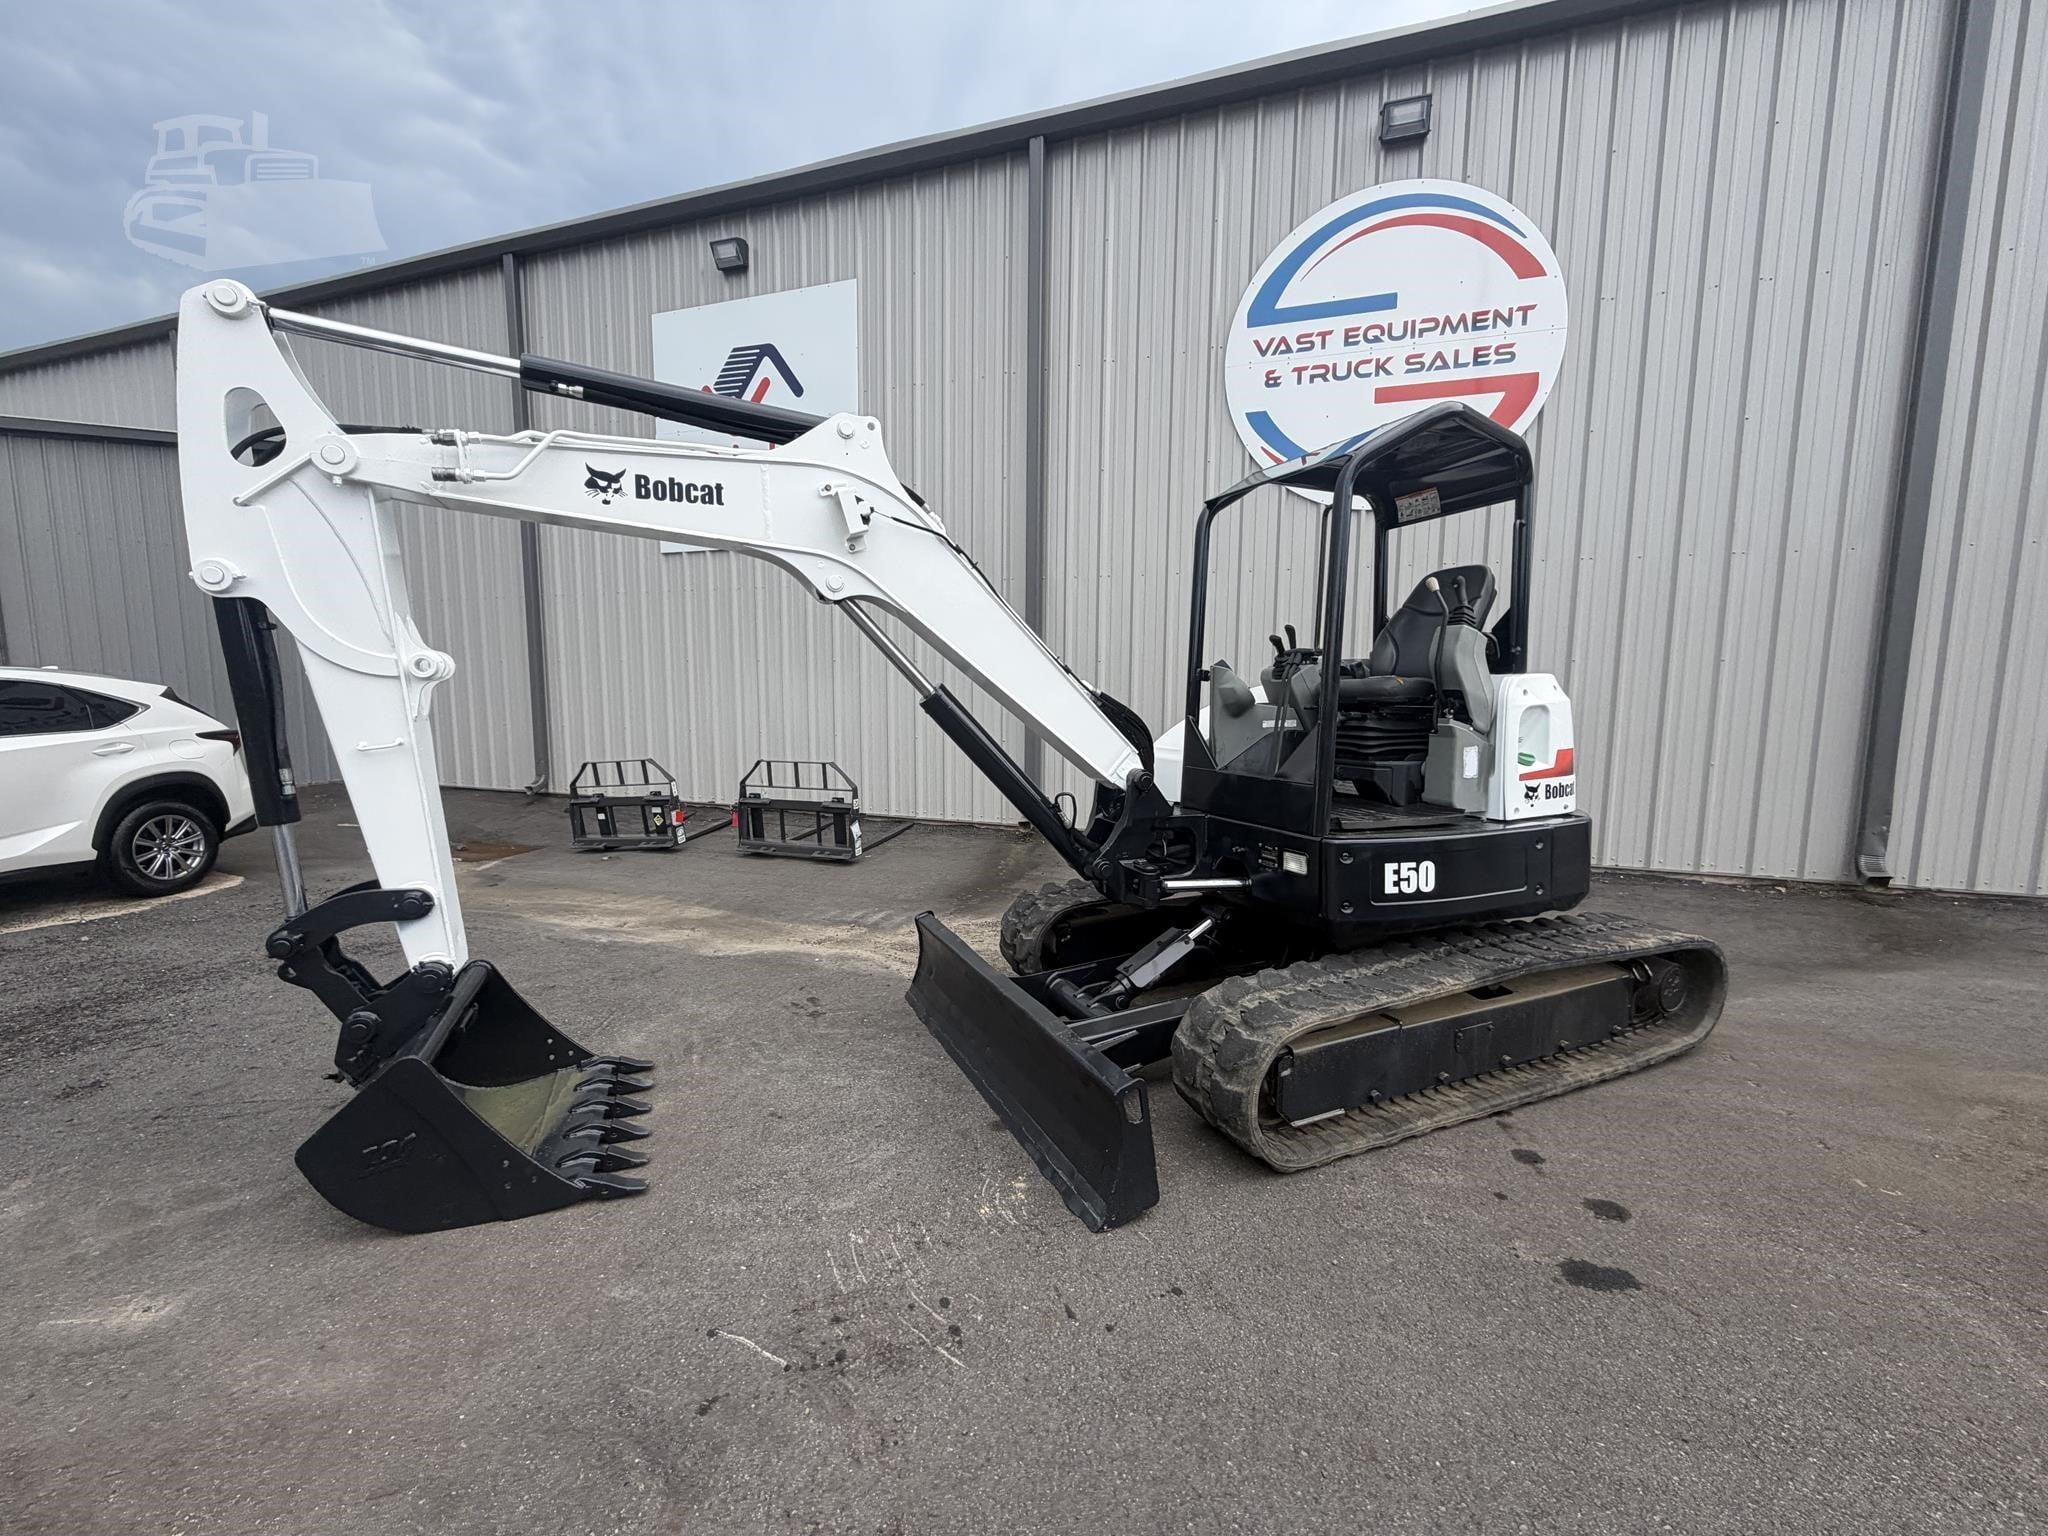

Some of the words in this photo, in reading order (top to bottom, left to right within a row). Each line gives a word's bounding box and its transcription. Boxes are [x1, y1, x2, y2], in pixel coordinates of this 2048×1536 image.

[1253, 329, 1335, 358] VAST
[1343, 304, 1538, 348] EQUIPMENT
[1264, 368, 1282, 389] &
[1291, 356, 1394, 386] TRUCK
[1403, 342, 1517, 375] SALES
[634, 473, 725, 506] Bobcat
[1545, 780, 1575, 800] Bobca
[1384, 860, 1436, 895] E50
